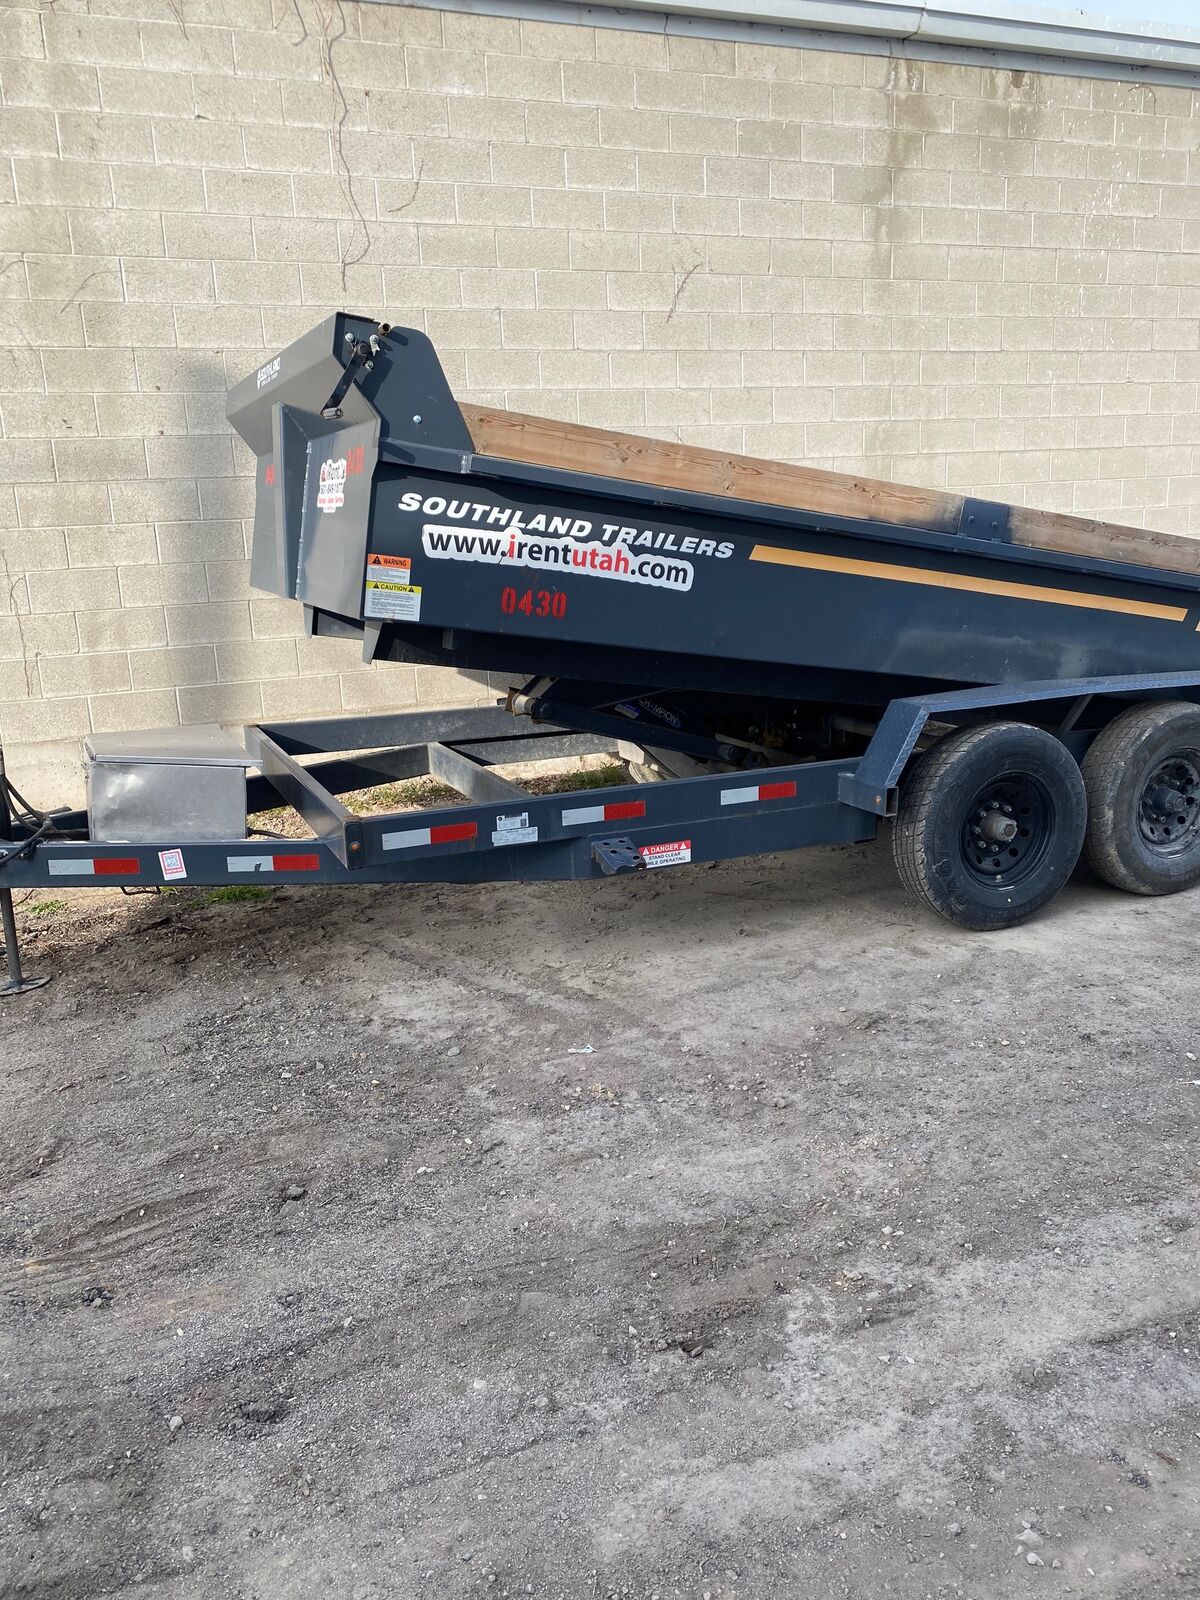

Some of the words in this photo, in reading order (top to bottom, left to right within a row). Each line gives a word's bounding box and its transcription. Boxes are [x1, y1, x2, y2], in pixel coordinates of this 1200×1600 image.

[397, 492, 593, 538] SOUTHLAND
[601, 523, 735, 559] TRAILERS
[383, 557, 407, 567] WARNING
[428, 532, 688, 585] www.irentutah.com
[380, 584, 408, 593] CAUTION
[501, 586, 567, 618] 0430
[650, 843, 679, 854] DANGER
[665, 851, 681, 859] CLEAR
[659, 856, 686, 865] OPERATING
